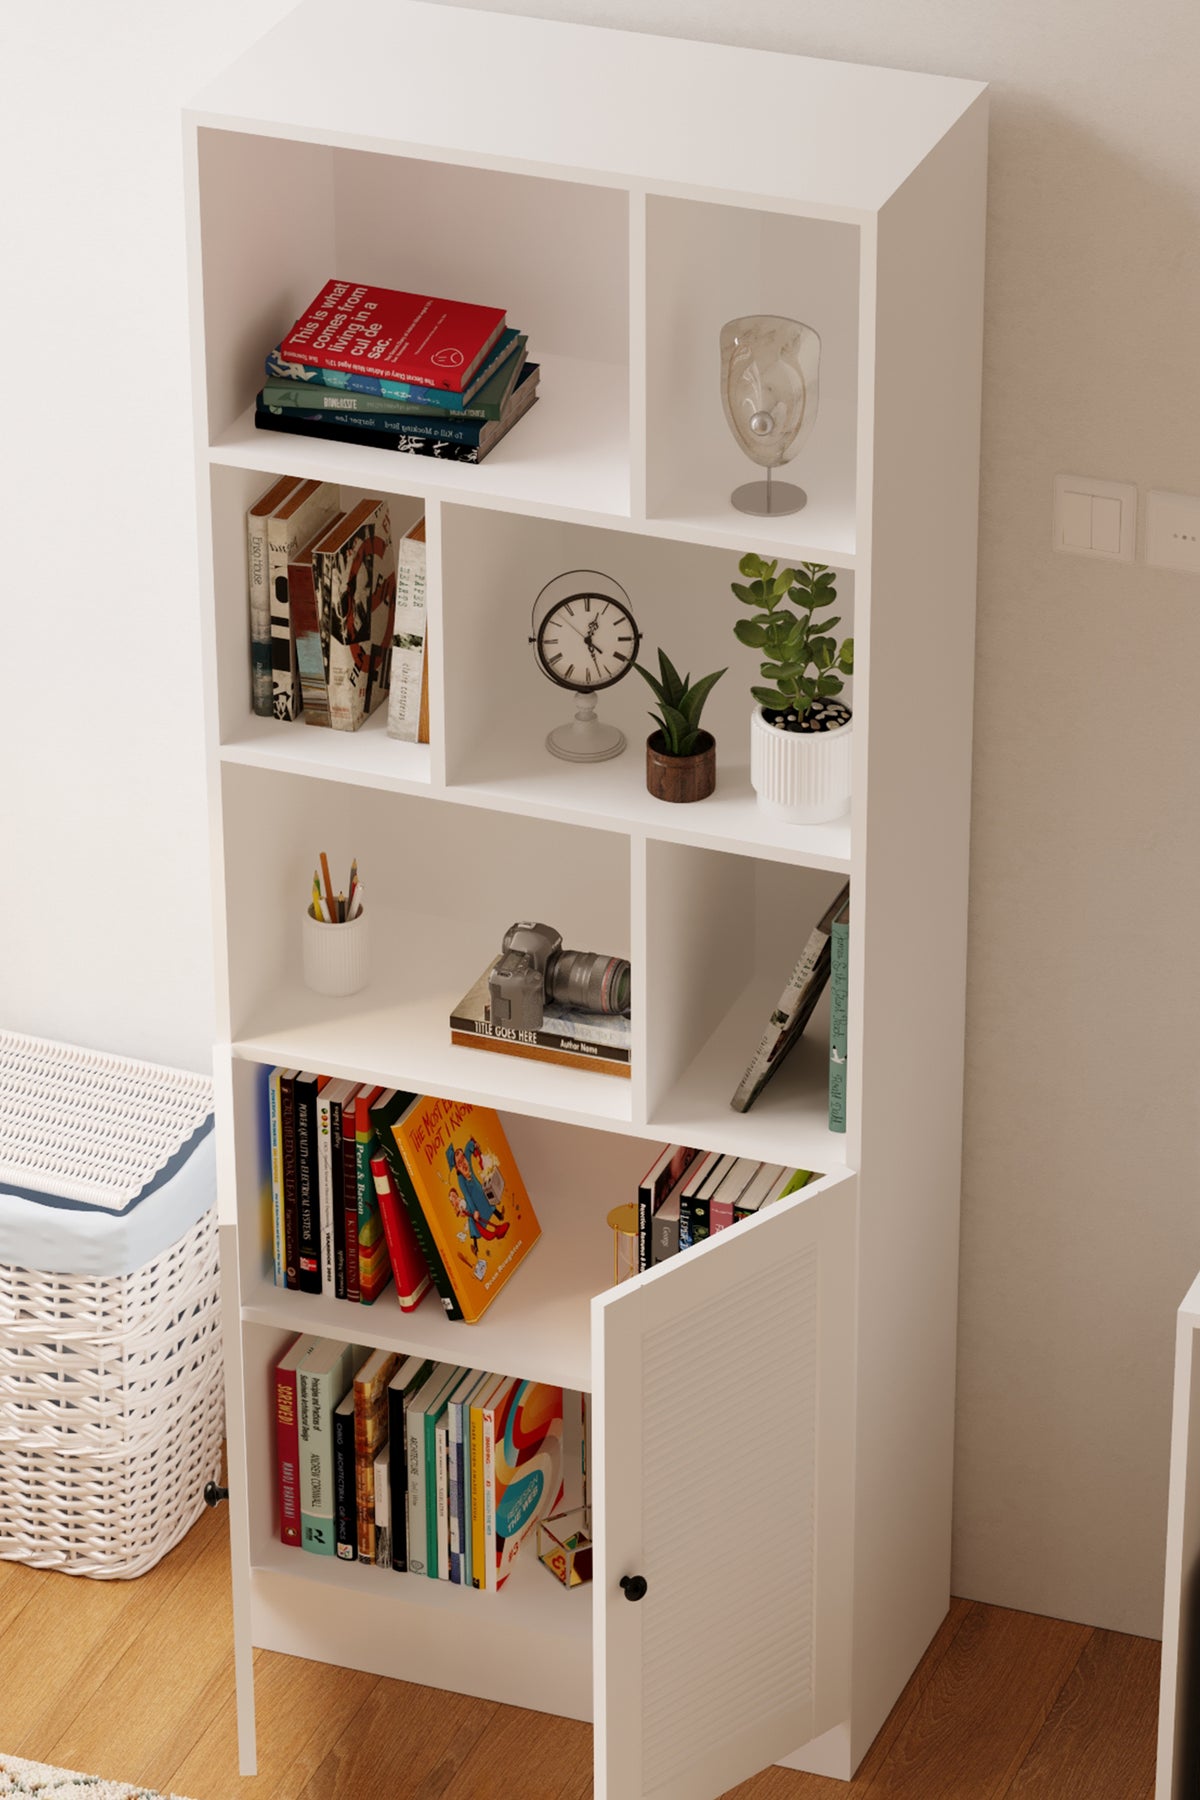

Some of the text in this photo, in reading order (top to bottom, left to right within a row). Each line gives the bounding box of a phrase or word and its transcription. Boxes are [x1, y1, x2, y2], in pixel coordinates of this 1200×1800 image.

[289, 283, 350, 344] This is what
[312, 313, 347, 349] comes
[337, 287, 368, 312] from
[327, 322, 364, 352] living
[350, 311, 371, 322] in
[364, 302, 378, 310] a
[350, 323, 383, 356] cul de
[367, 338, 392, 359] sac.
[338, 361, 351, 369] Aged
[366, 366, 384, 376] Adrian
[391, 373, 405, 381] Diary
[405, 375, 422, 384] Secret
[253, 559, 263, 585] House
[474, 1021, 537, 1044] TITLE GOES HERE
[560, 1039, 598, 1055] Author Name
[298, 1103, 308, 1126] POWER
[409, 1129, 425, 1152] THE
[422, 1106, 442, 1136] MOST
[298, 1127, 309, 1158] QUALITY
[424, 1128, 445, 1165] IDIOT
[301, 1165, 310, 1207] ELECTRICAL
[357, 1173, 364, 1181] &
[303, 1209, 311, 1241] SYSTEMS
[277, 1383, 293, 1426] SCREWED!
[310, 1453, 322, 1508] ANDREW CORNWALL
[507, 1513, 522, 1533] THE
[522, 1487, 539, 1513] WEB
